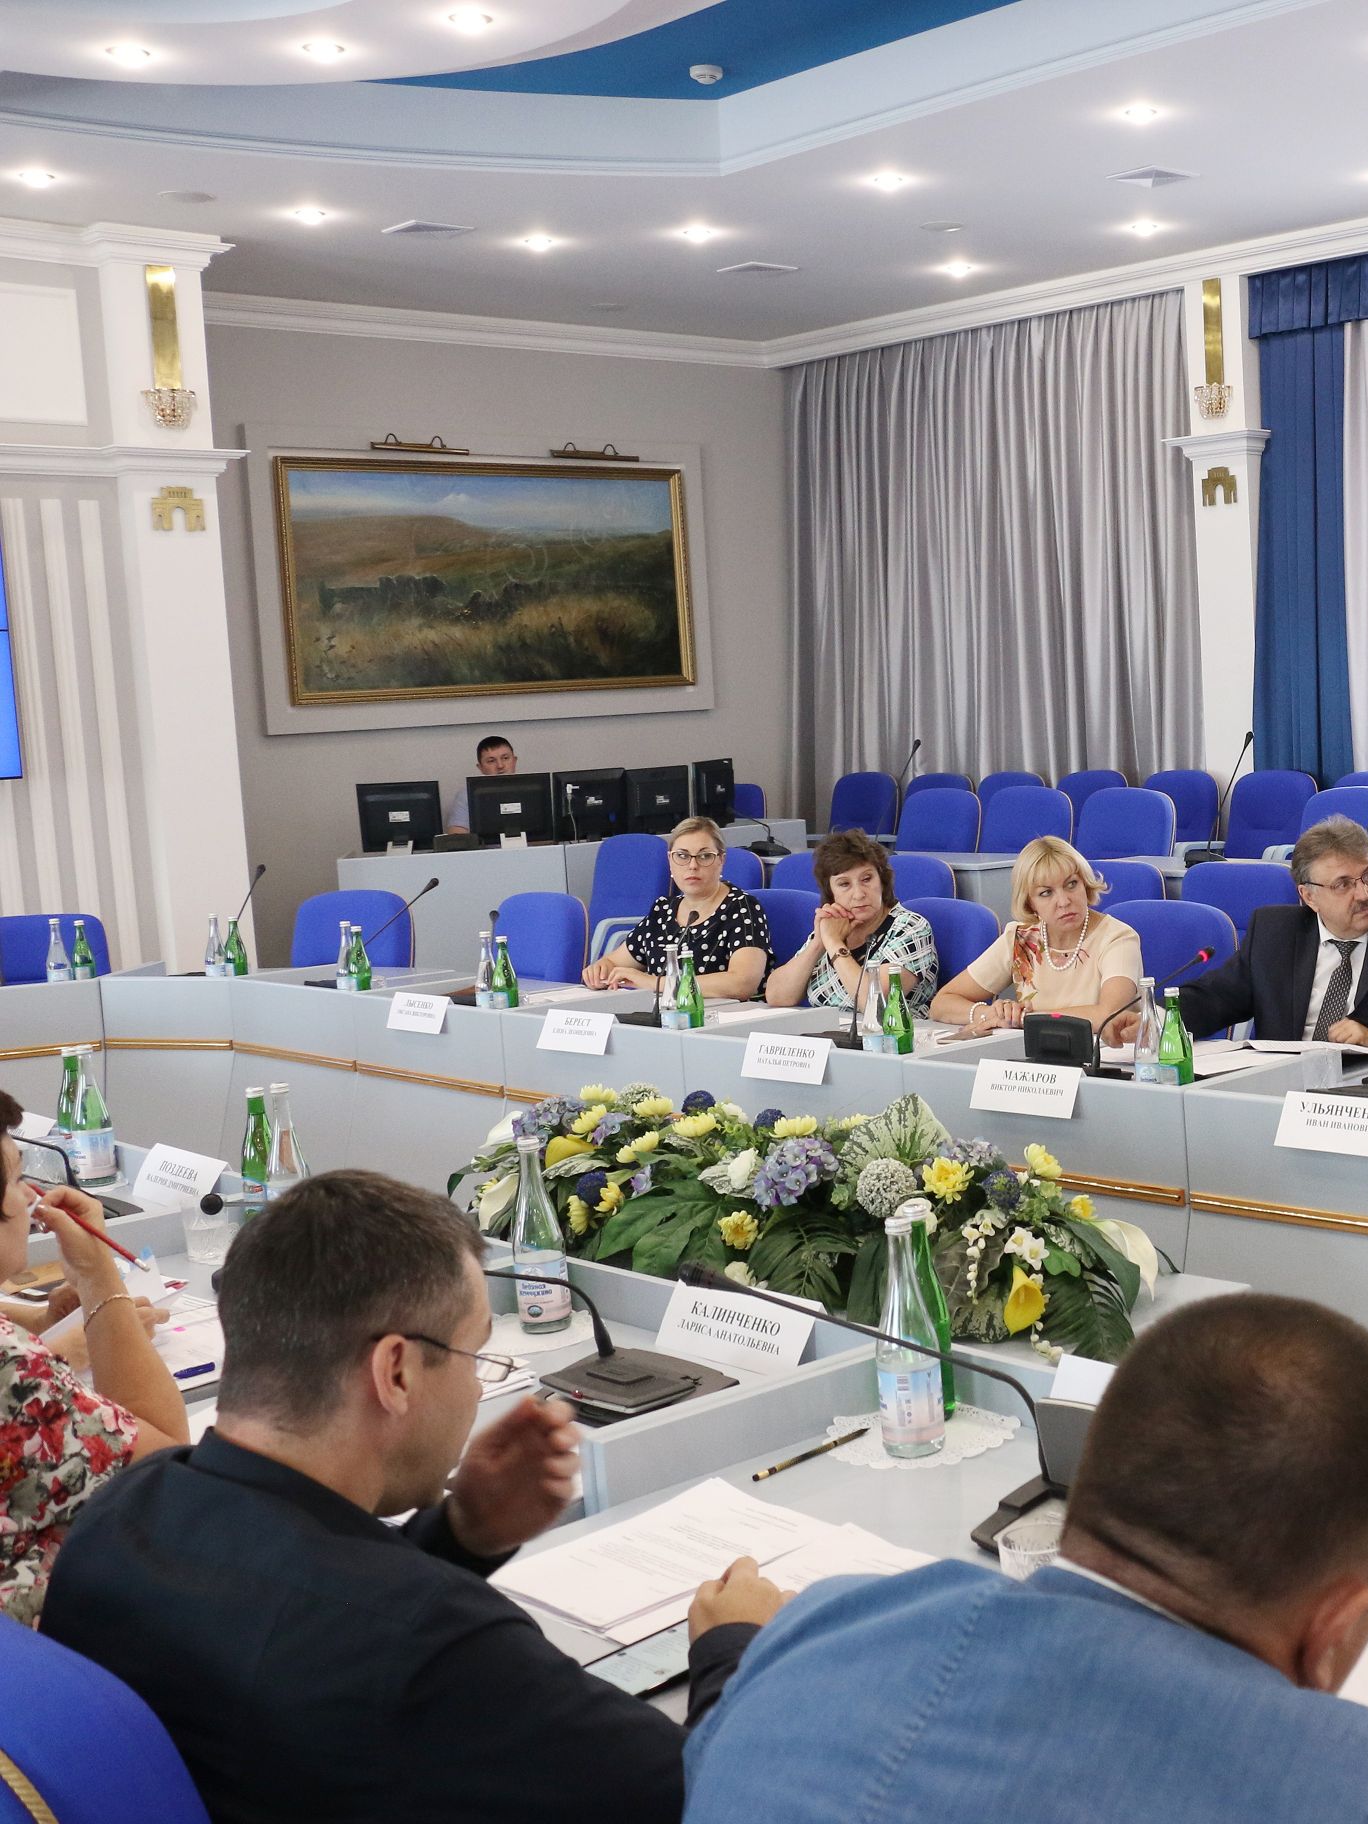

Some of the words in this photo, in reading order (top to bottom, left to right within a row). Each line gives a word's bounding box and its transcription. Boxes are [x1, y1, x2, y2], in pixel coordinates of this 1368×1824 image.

[564, 1017, 592, 1027] БЕРЕСТ
[758, 1044, 815, 1059] ГАВРИЛЕНКО
[1003, 1070, 1057, 1084] МАЖАРОВ
[990, 1083, 1017, 1092] ВИКТОР
[1017, 1086, 1064, 1097] НИКОЛАЕВИЧ
[1305, 1118, 1329, 1129] ИВАН
[159, 1160, 199, 1182] ПОЗДЕЕВА
[690, 1300, 781, 1336] КАЛИНЧЕНКО
[677, 1318, 712, 1337] ЛАРИСА
[714, 1328, 781, 1355] АНАТОЛЬЕВНА
